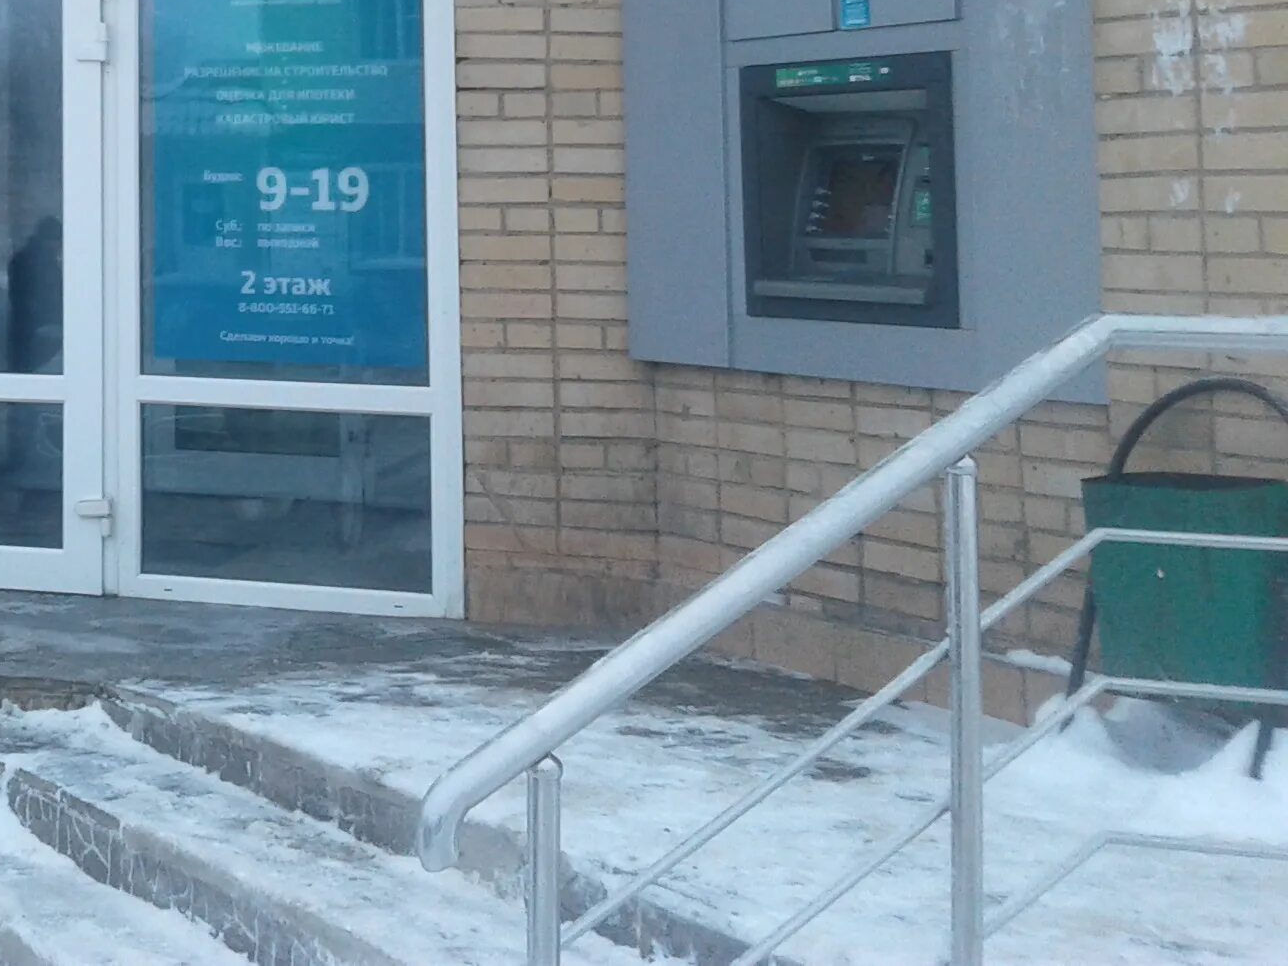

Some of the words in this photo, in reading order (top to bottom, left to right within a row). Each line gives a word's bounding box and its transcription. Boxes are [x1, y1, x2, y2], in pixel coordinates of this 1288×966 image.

[256, 166, 369, 212] 9-19
[240, 270, 256, 295] 2
[263, 277, 332, 296] этаж
